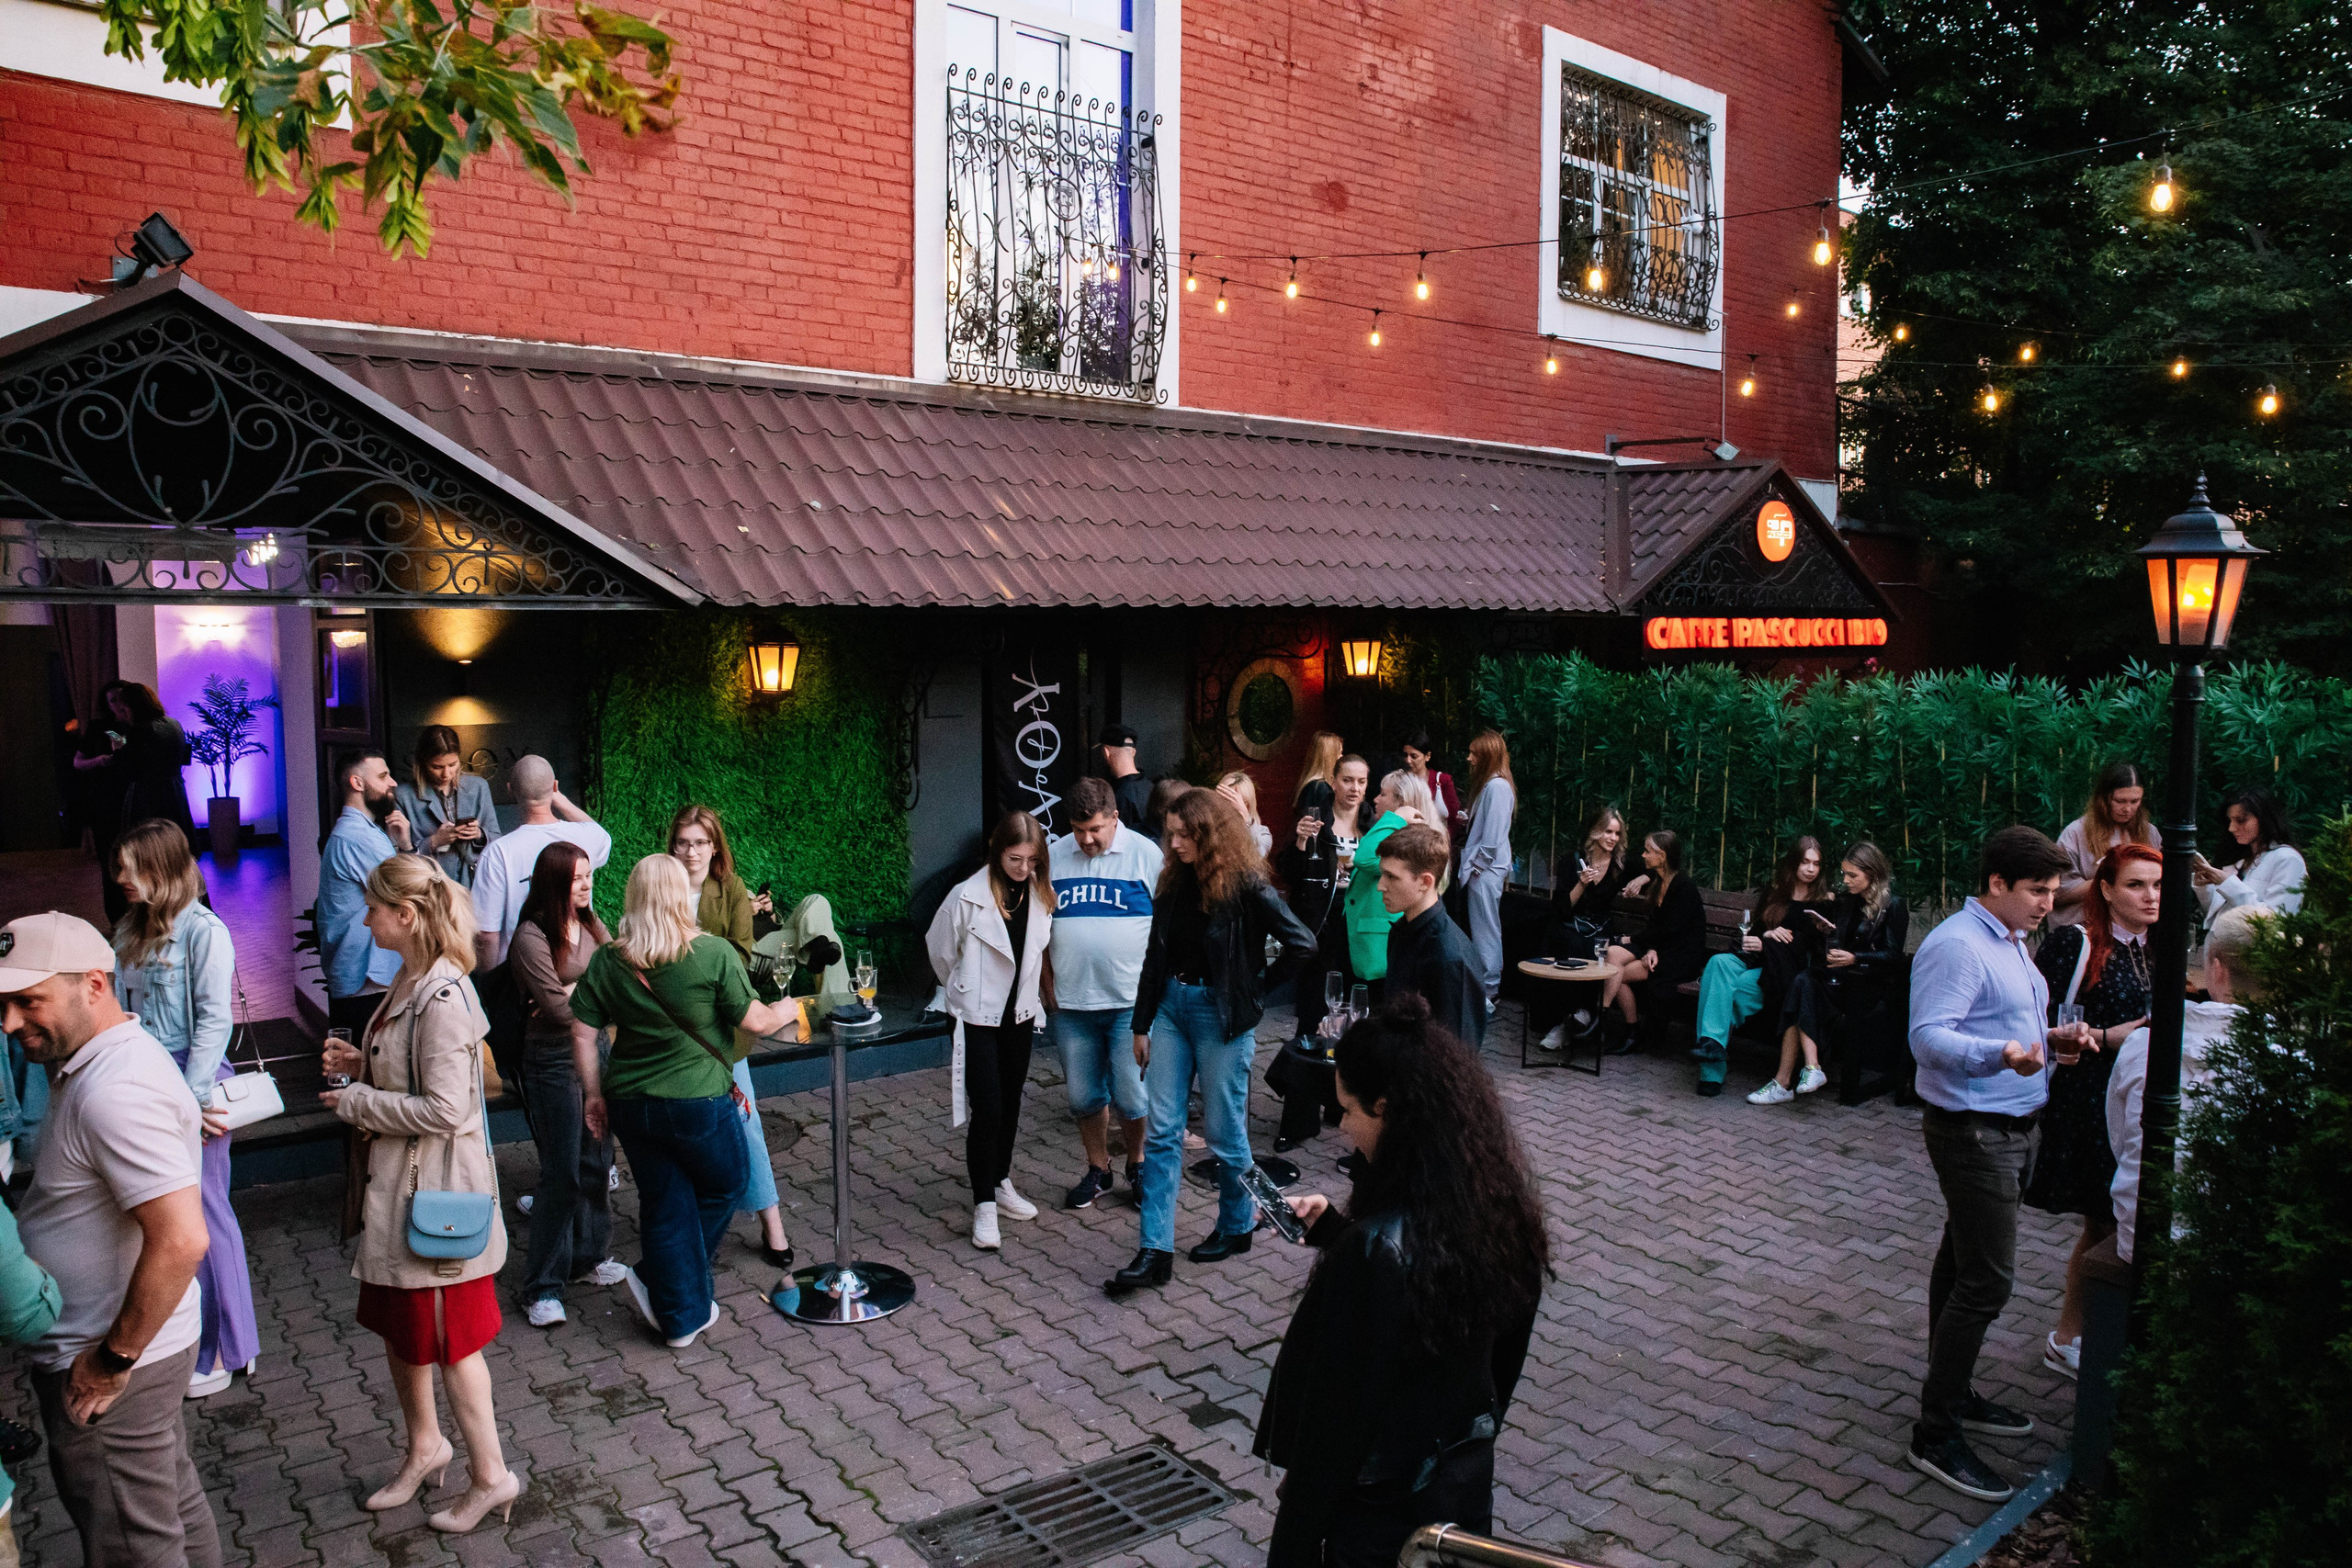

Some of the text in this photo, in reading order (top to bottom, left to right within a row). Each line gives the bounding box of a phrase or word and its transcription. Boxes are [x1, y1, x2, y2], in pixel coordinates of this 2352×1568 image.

[1647, 617, 1887, 649] CAFFE PASCUCCI BIO
[1012, 672, 1063, 844] VOY
[1057, 884, 1128, 910] CHILL
